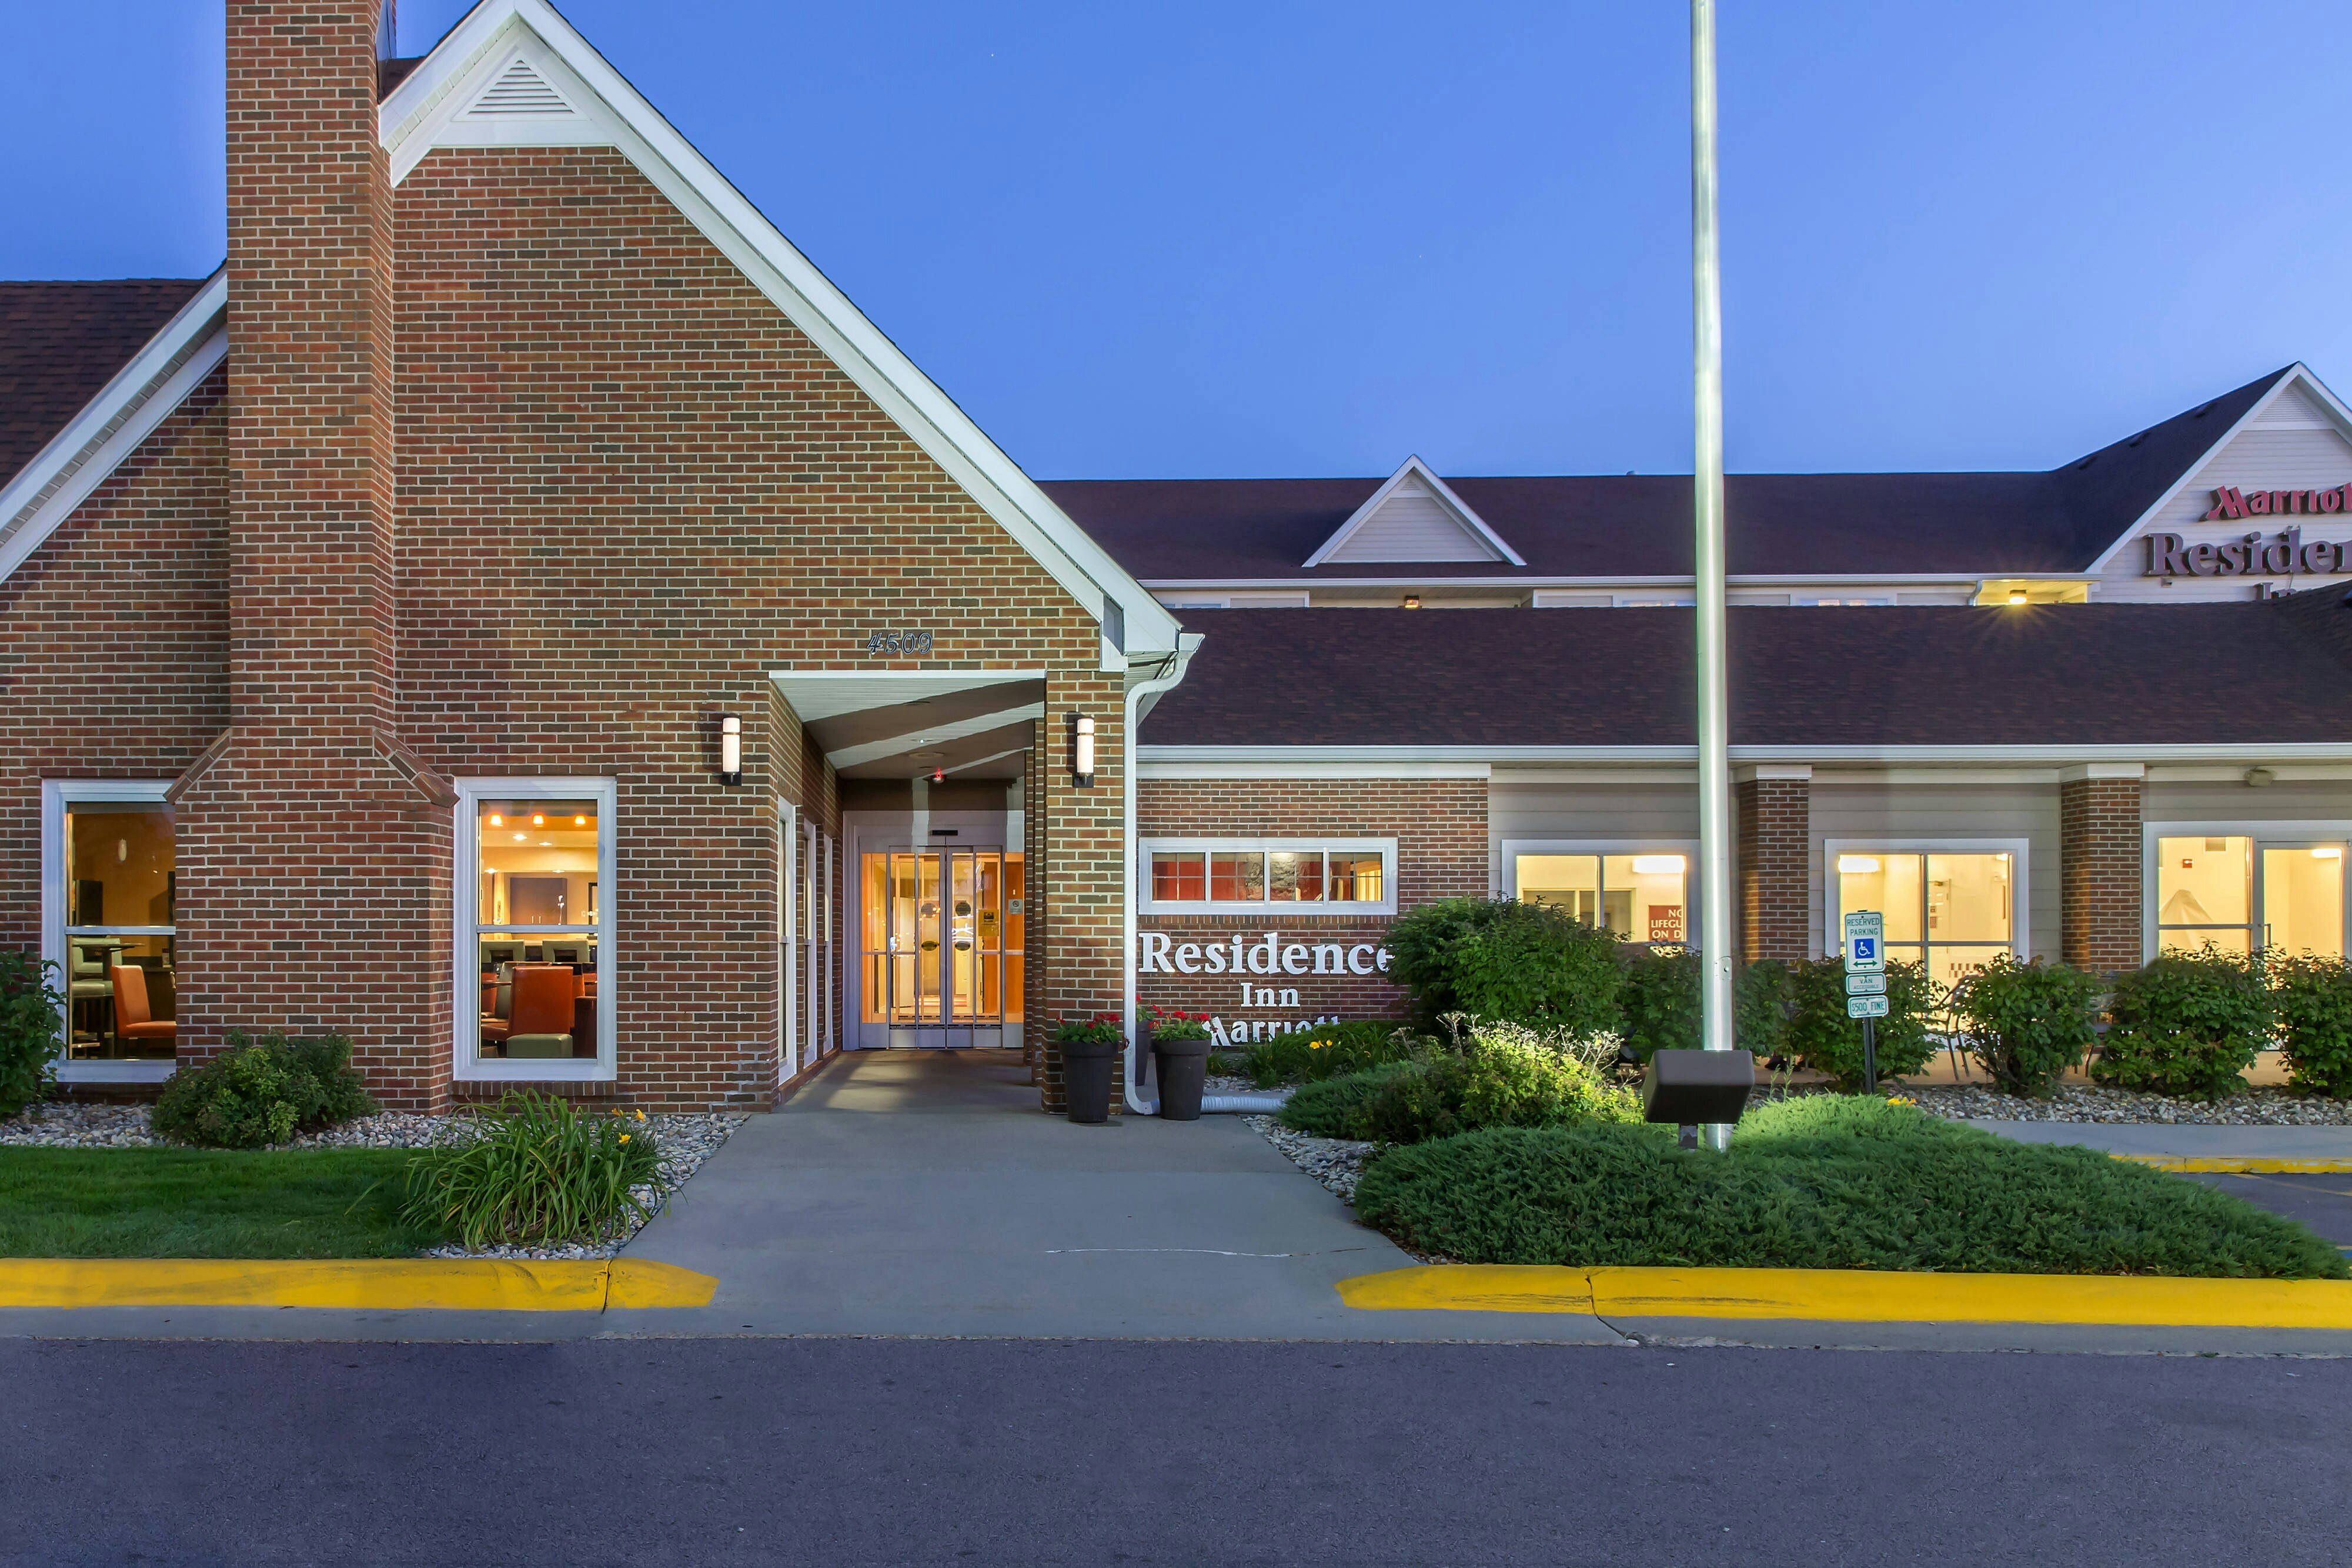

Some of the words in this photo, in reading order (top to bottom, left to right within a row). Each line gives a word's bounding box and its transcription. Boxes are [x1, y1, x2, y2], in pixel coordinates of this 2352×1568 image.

[867, 632, 933, 655] 4509
[1847, 918, 1880, 926] RESERVED
[1652, 930, 1669, 938] ON
[1850, 928, 1879, 936] PARKING
[1240, 982, 1301, 1007] Inn
[1851, 1002, 1867, 1012] $500
[1870, 1001, 1885, 1011] FINE
